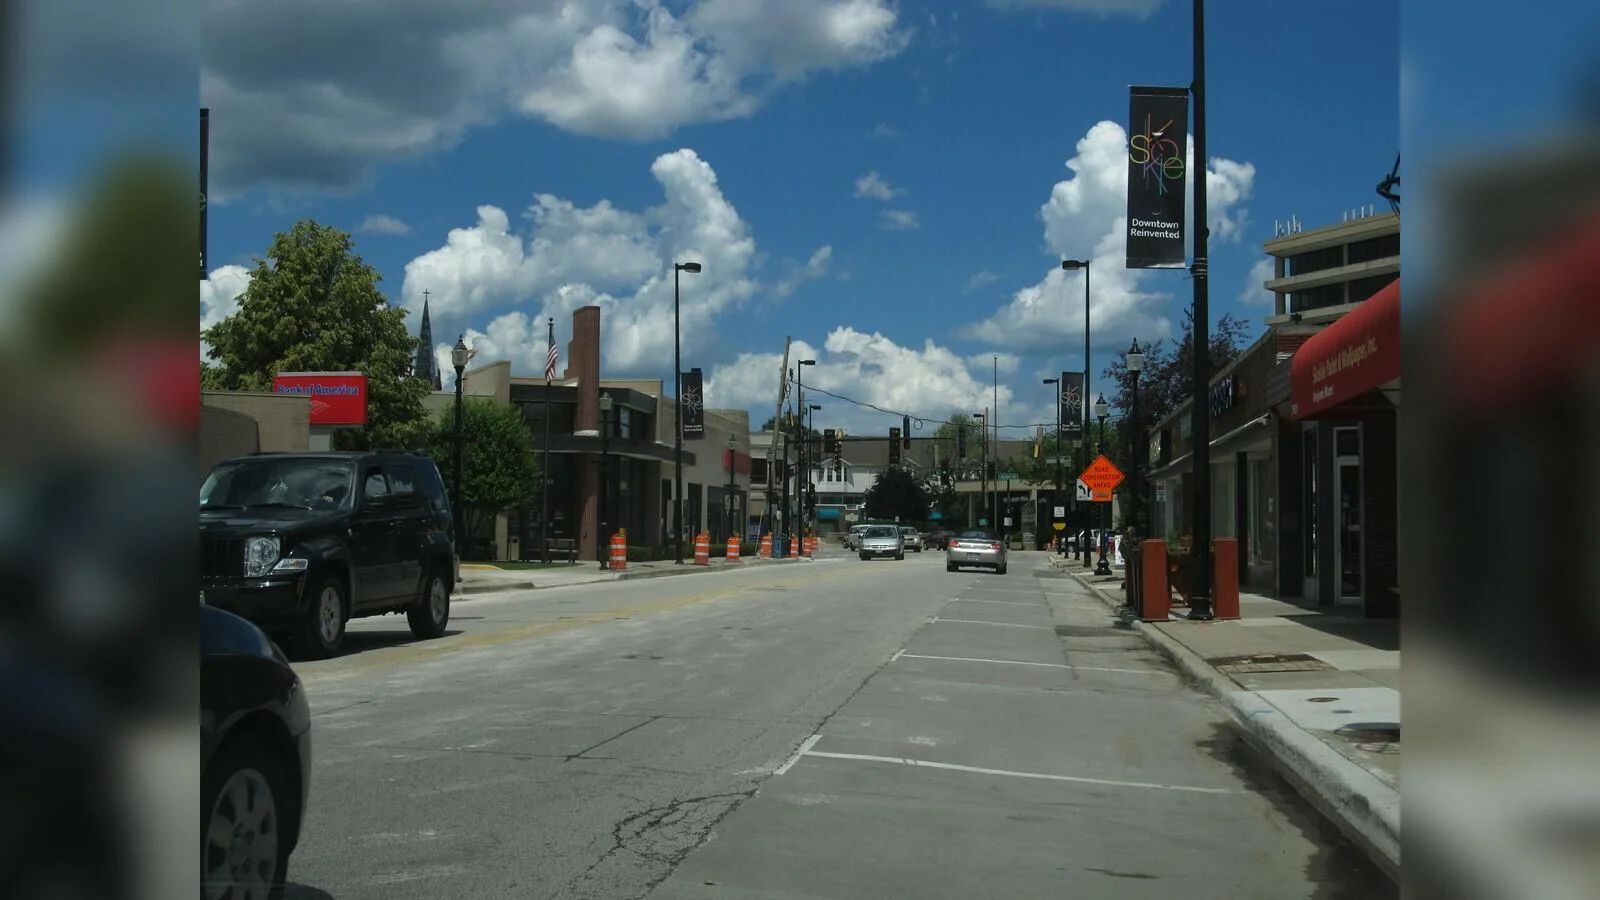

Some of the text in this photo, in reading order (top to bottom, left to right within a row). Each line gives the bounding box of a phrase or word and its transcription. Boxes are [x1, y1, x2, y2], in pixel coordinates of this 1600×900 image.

[1132, 219, 1179, 229] Downtown
[1131, 229, 1180, 239] Reinvented
[278, 383, 359, 395] Bank of America
